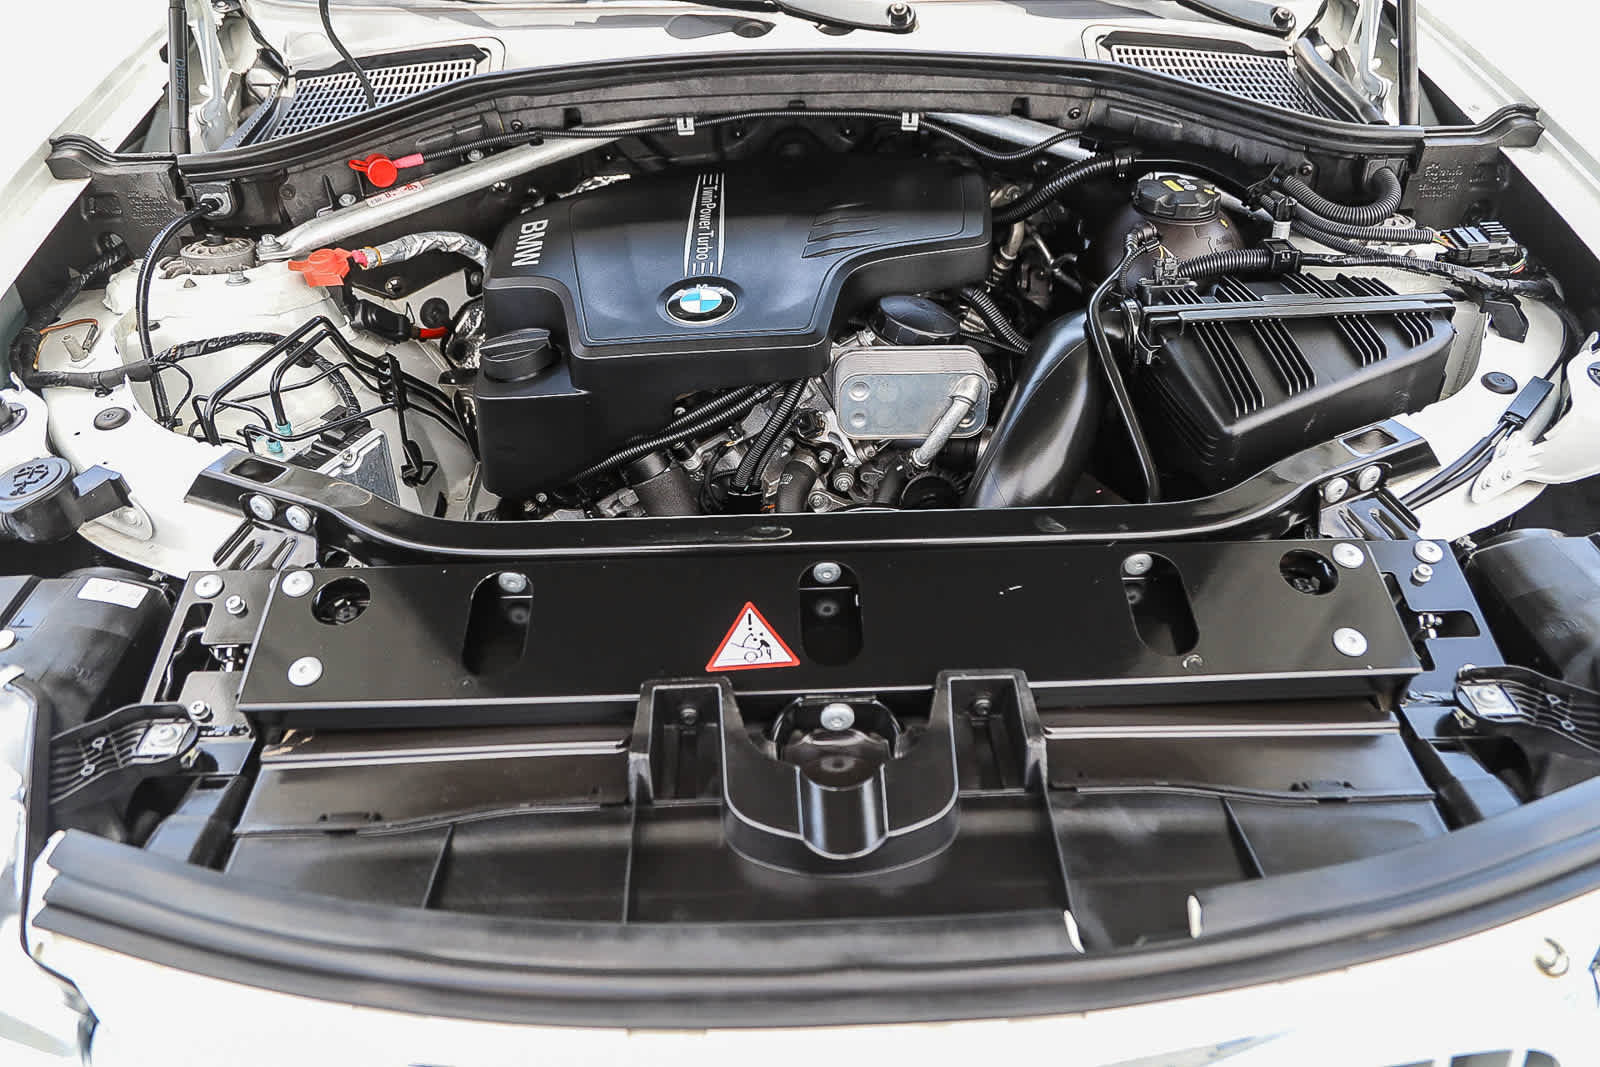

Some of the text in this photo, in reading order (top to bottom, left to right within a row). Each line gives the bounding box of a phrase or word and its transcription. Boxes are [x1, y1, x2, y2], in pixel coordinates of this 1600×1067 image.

[511, 219, 549, 267] BMW
[696, 185, 718, 260] TwinPower Turbo
